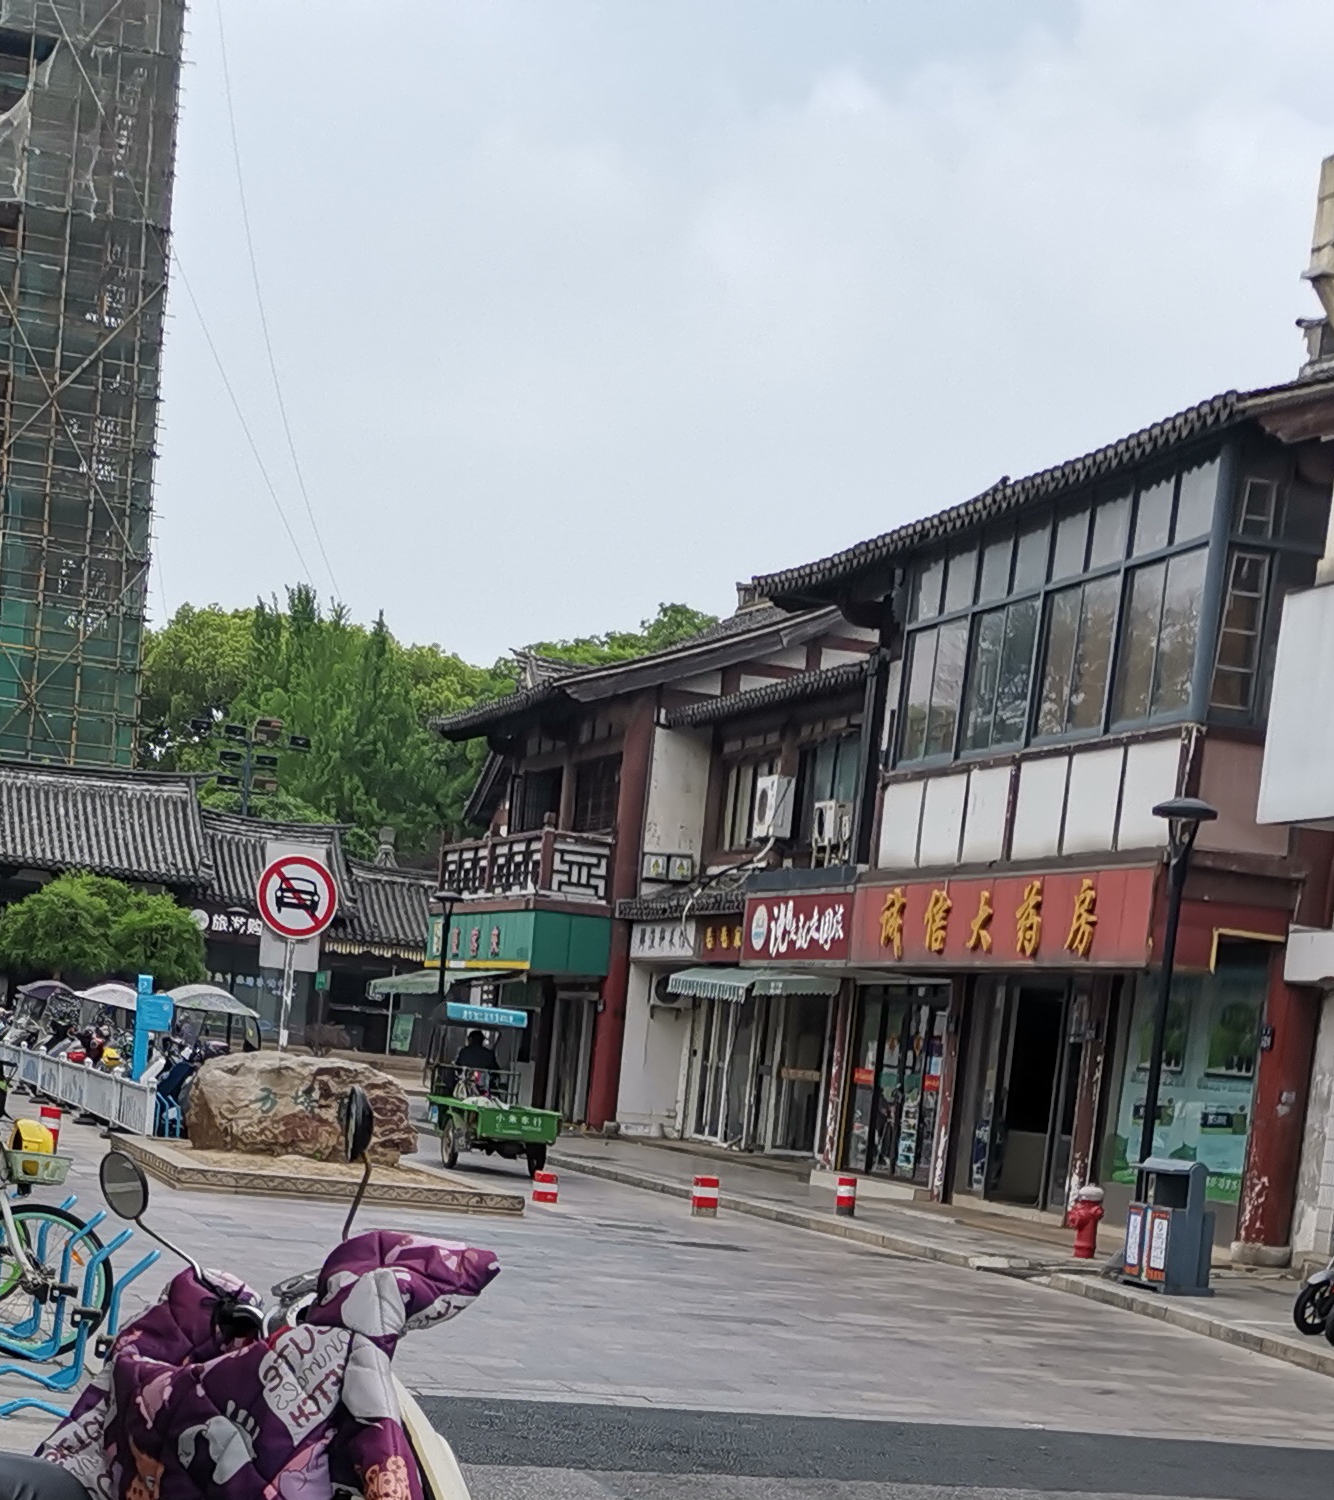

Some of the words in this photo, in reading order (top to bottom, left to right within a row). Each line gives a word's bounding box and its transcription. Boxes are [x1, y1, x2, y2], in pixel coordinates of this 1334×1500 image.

[879, 878, 1098, 961] 诚信大药房
